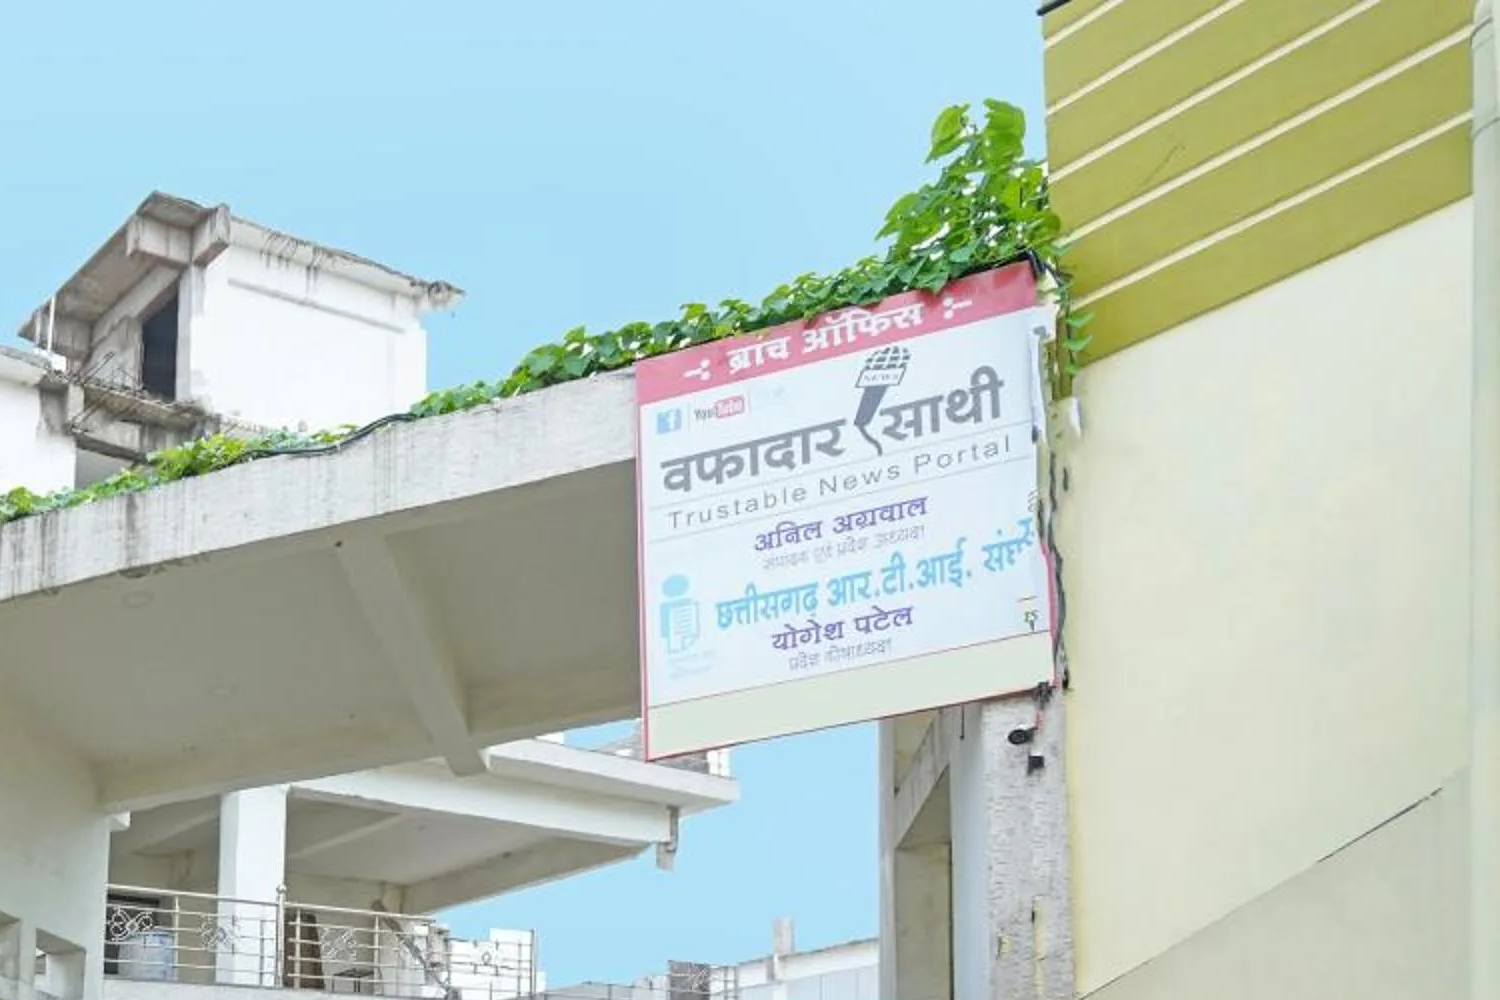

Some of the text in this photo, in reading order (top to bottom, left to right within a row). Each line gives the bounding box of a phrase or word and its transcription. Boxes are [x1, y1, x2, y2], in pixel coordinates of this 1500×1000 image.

[803, 304, 924, 354] ऑफिस
[660, 365, 1004, 493] वफादार साथी
[669, 435, 1011, 529] Trustable News Portal
[754, 495, 928, 551] अनिल अग्रवाल
[716, 581, 819, 629] छत्तीसगढ़
[772, 605, 913, 650] योगेश पटेल
